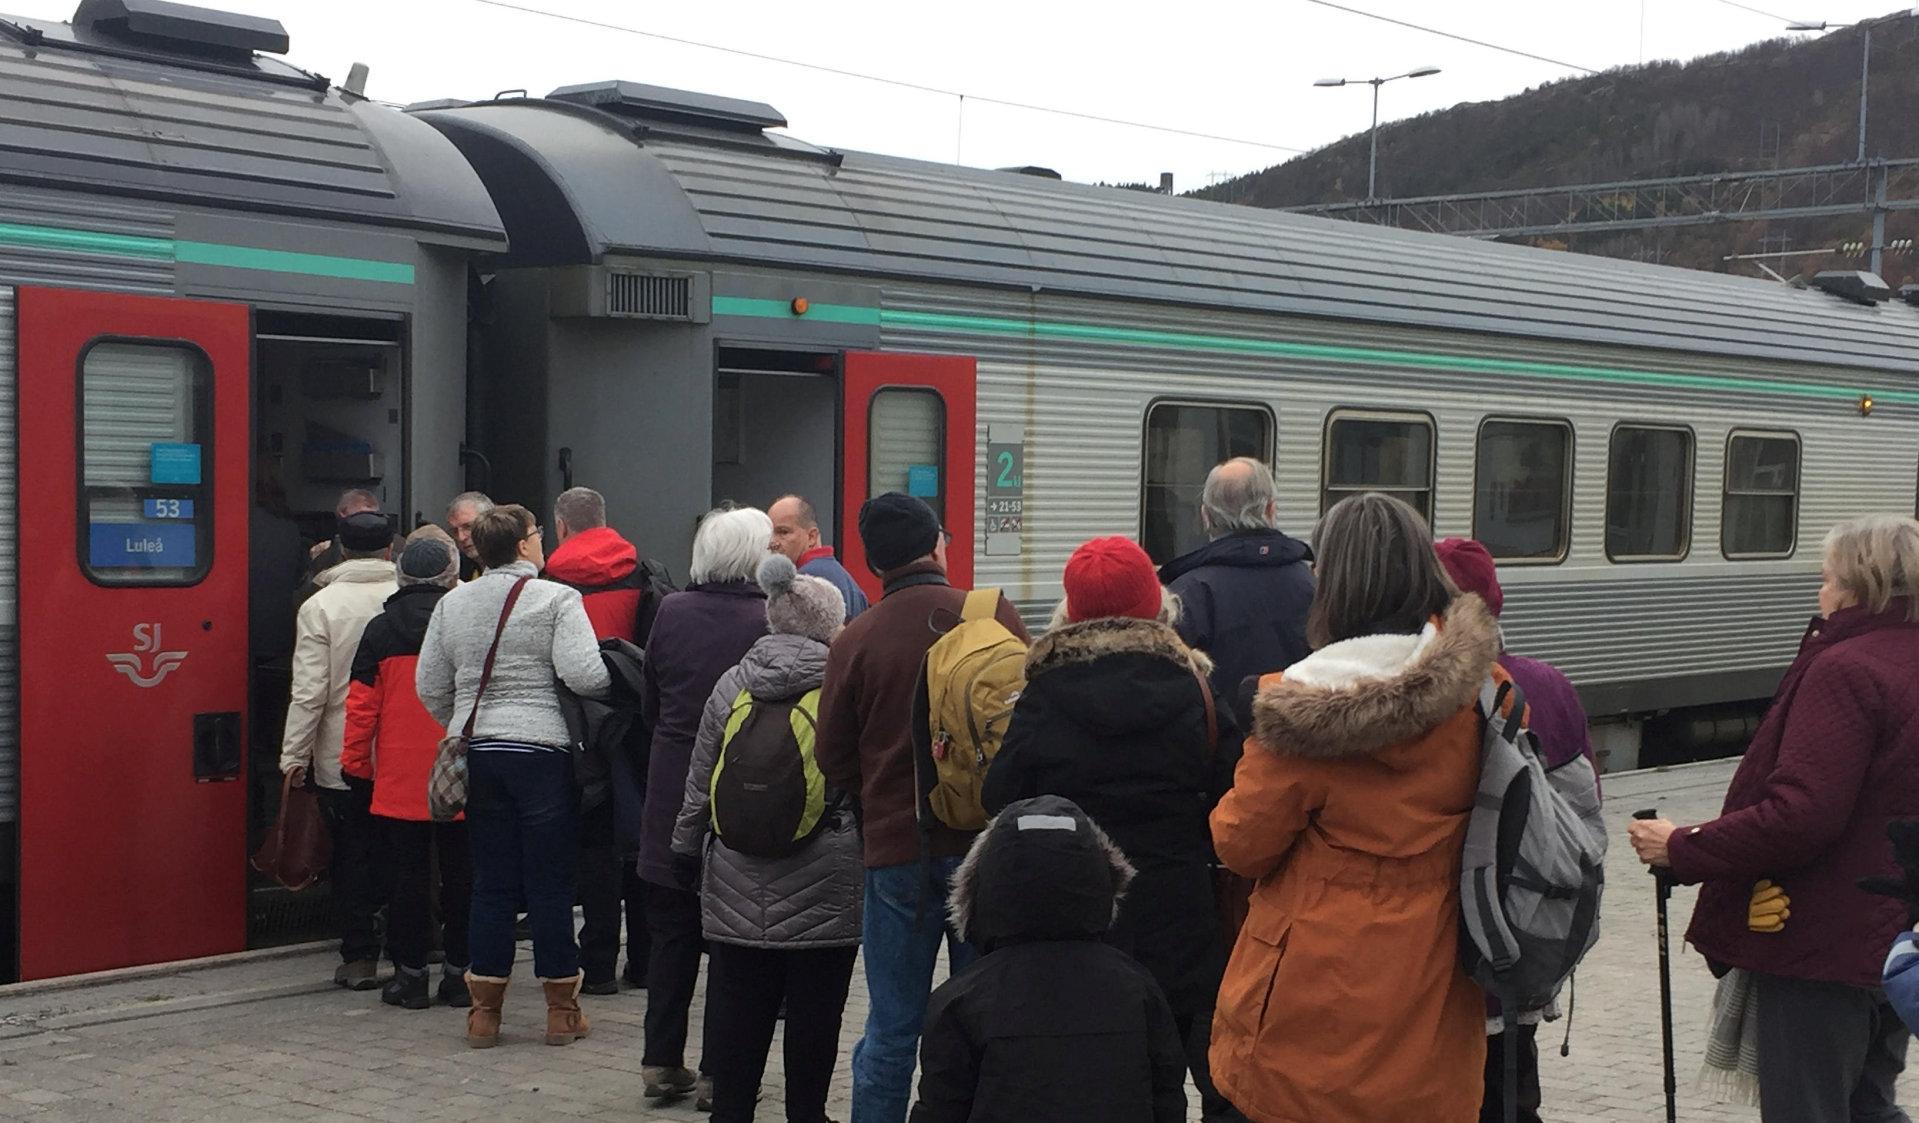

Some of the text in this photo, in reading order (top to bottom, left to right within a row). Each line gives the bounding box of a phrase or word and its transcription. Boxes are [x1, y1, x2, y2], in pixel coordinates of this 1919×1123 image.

[997, 451, 1013, 487] 2
[156, 499, 180, 518] 53
[999, 501, 1021, 512] 21-53
[126, 537, 164, 553] Luleå
[133, 622, 162, 653] SJ
